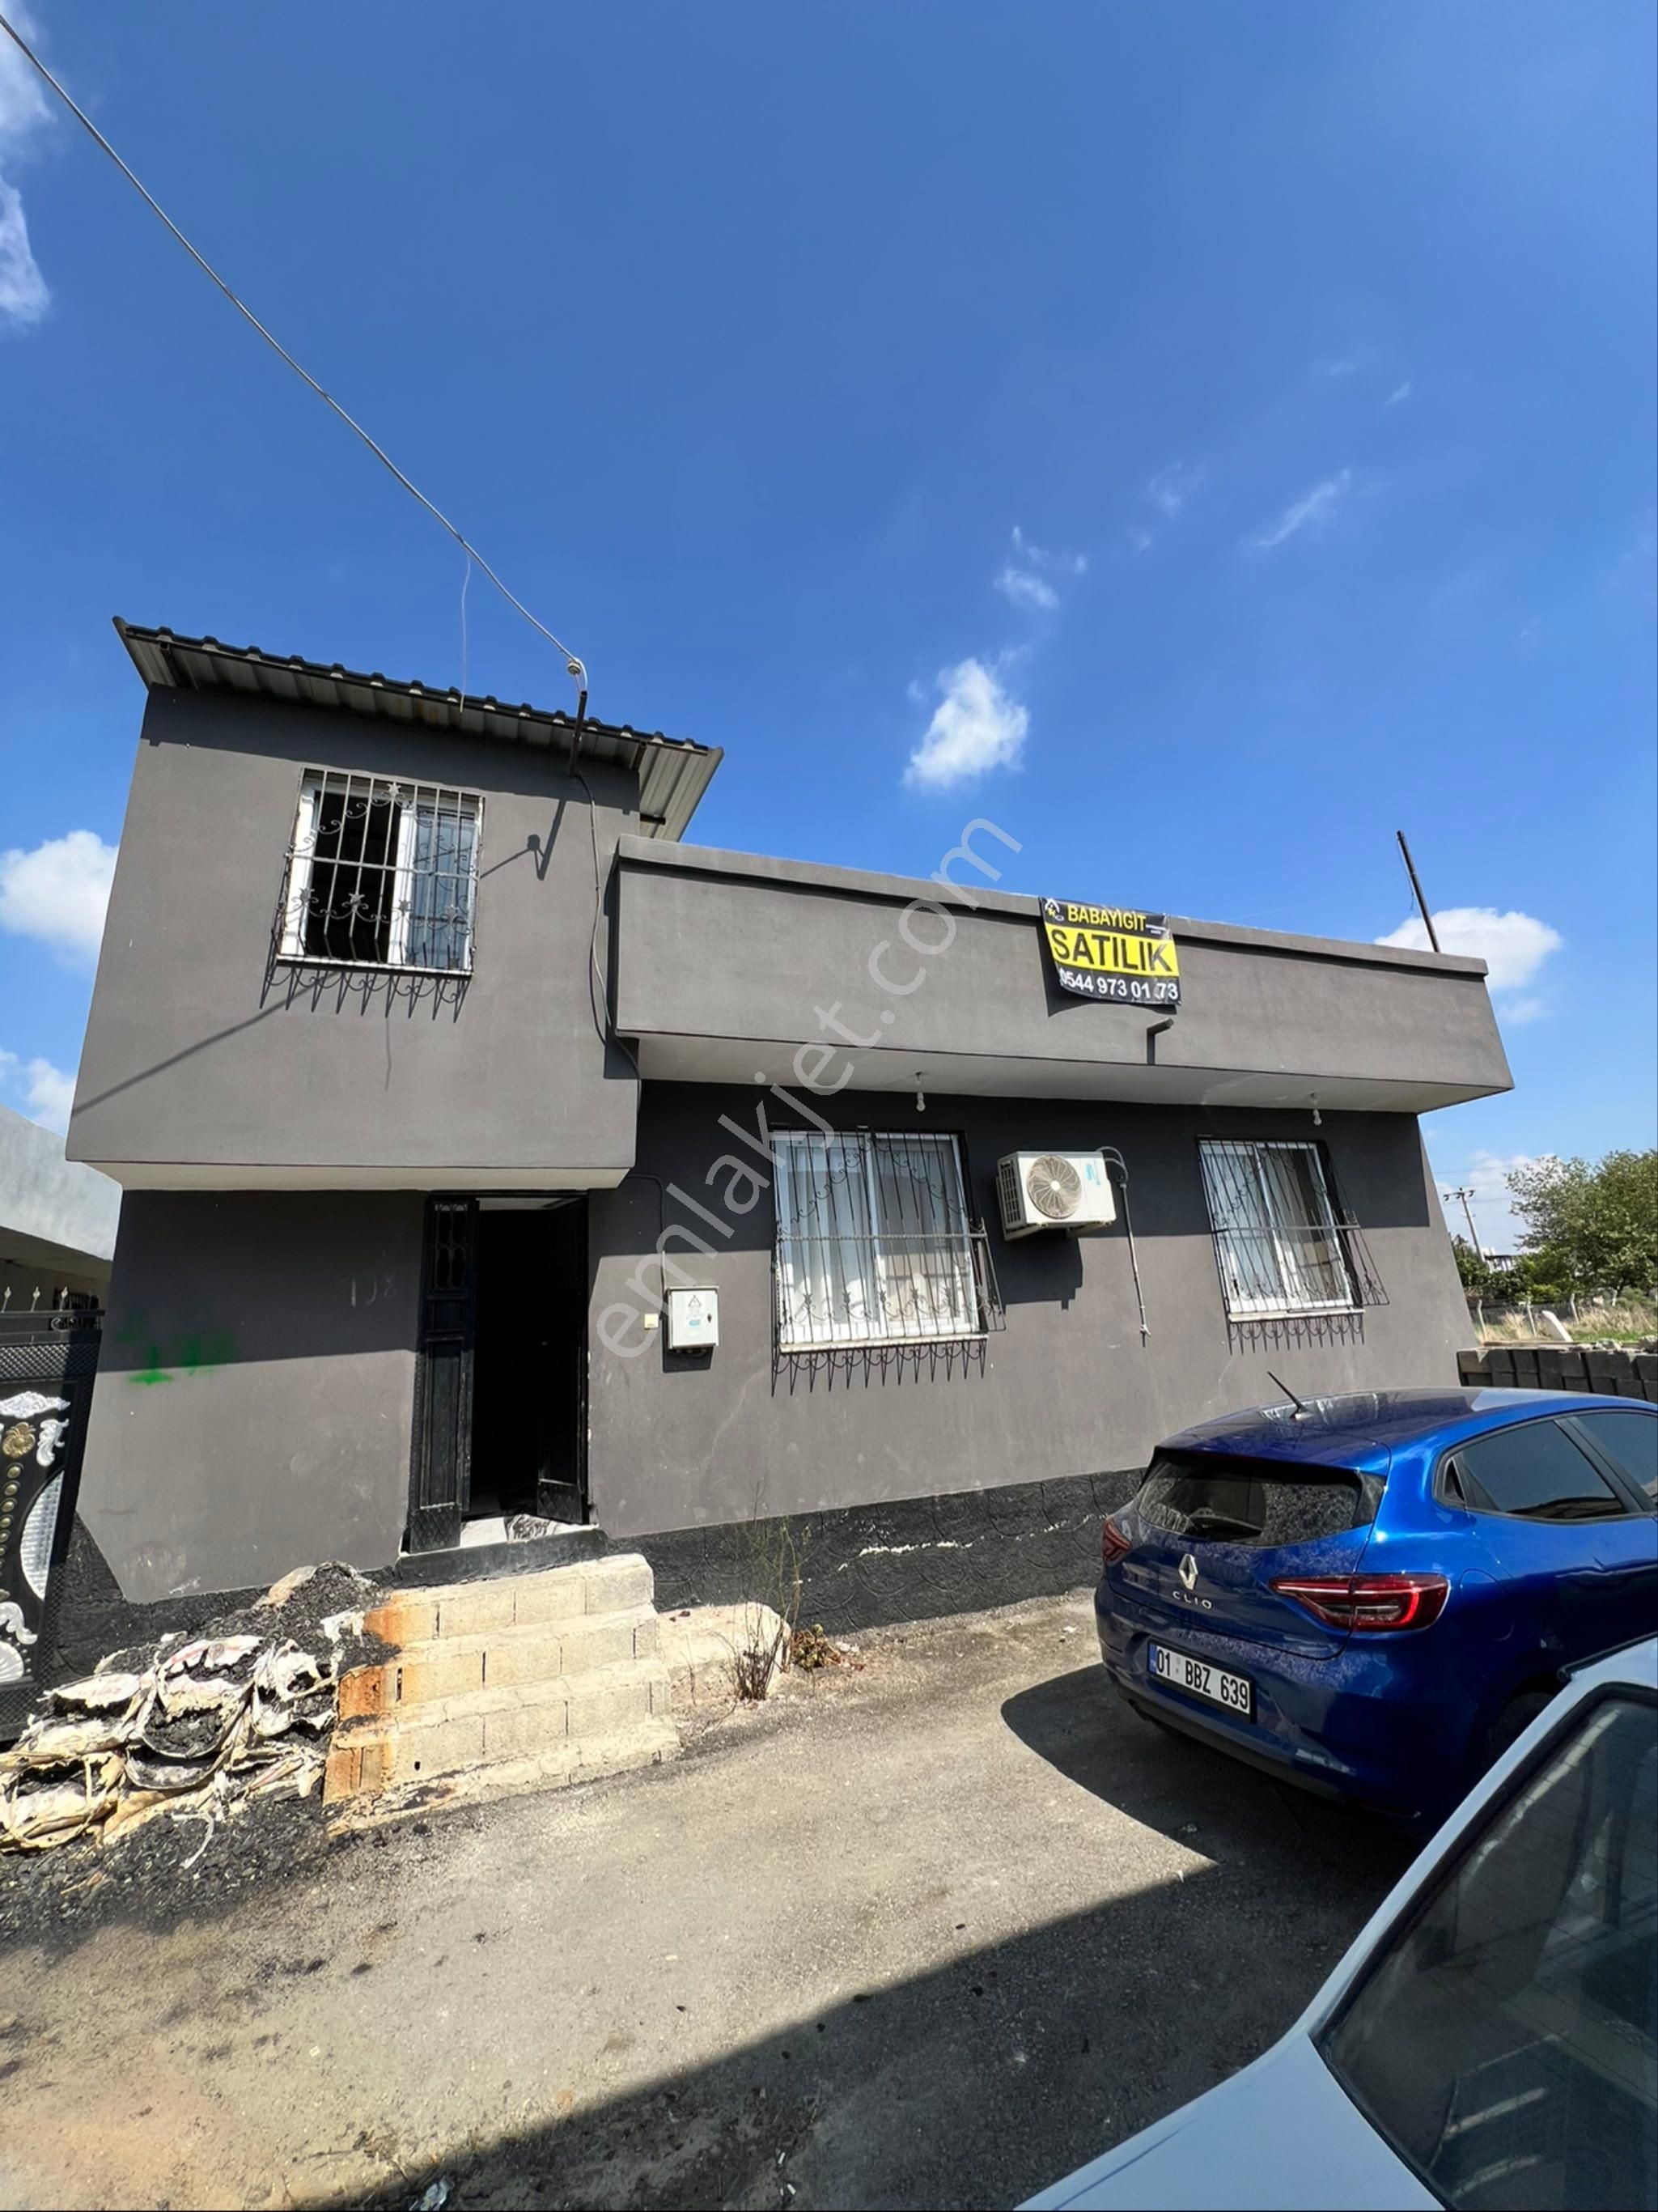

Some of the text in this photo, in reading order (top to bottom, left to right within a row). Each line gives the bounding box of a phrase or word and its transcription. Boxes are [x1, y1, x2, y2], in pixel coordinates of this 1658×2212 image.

[1052, 929, 1172, 972] SATILIK
[1060, 968, 1179, 1000] 0544 973 01 73
[1172, 1590, 1212, 1609] CLIO
[1157, 1649, 1248, 1709] 01 BBZ 639
